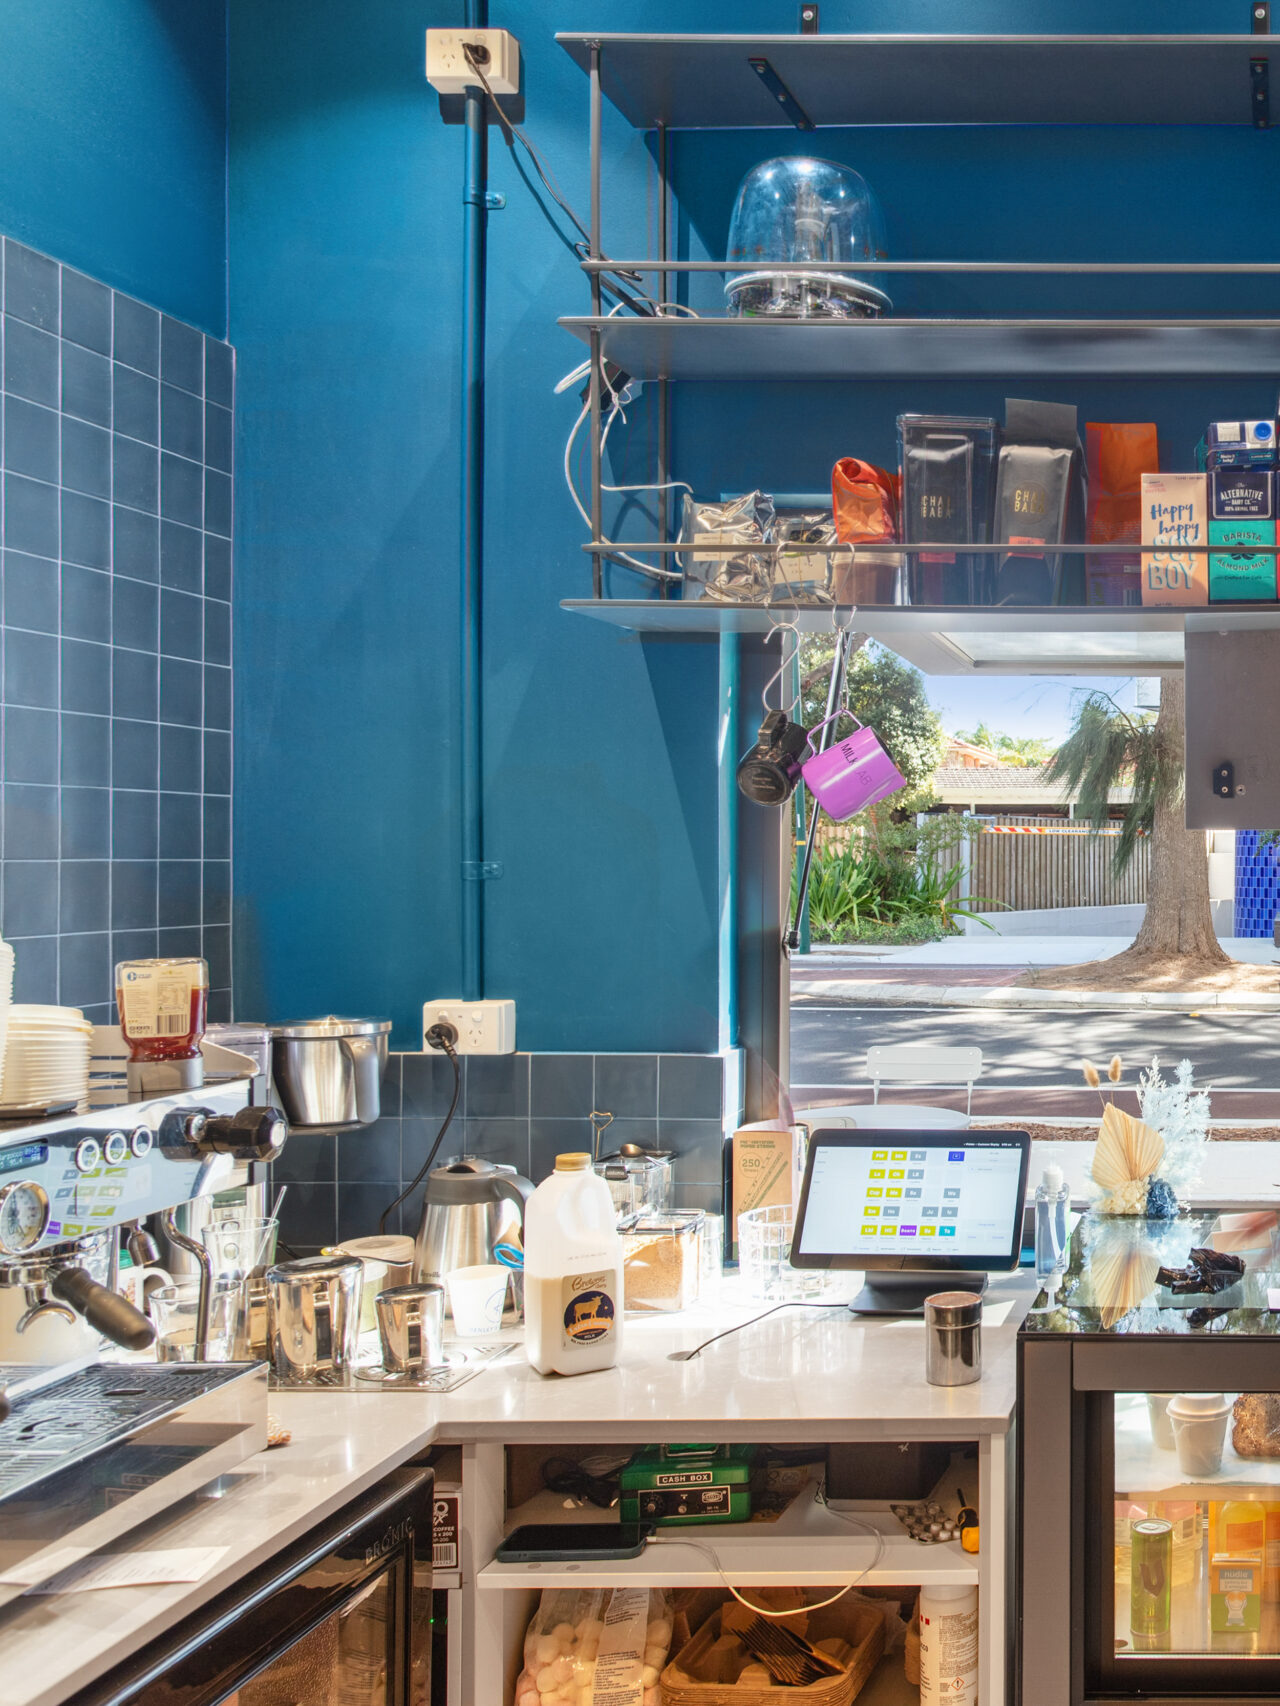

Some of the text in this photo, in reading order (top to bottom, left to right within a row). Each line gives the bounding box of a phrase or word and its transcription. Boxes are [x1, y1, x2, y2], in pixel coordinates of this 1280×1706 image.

[921, 495, 951, 507] CHAI
[1015, 490, 1045, 502] CHAI
[1220, 489, 1264, 501] ALTERNATIVE
[920, 507, 952, 518] BABA
[1014, 500, 1045, 514] BABA
[1150, 503, 1193, 523] Happy
[1159, 520, 1200, 540] happy
[1223, 531, 1262, 542] BARISTA
[1216, 557, 1269, 571] ALMOND MILK
[1148, 562, 1199, 590] BOY
[742, 1159, 760, 1168] 250
[661, 1473, 709, 1483] CASH BOX
